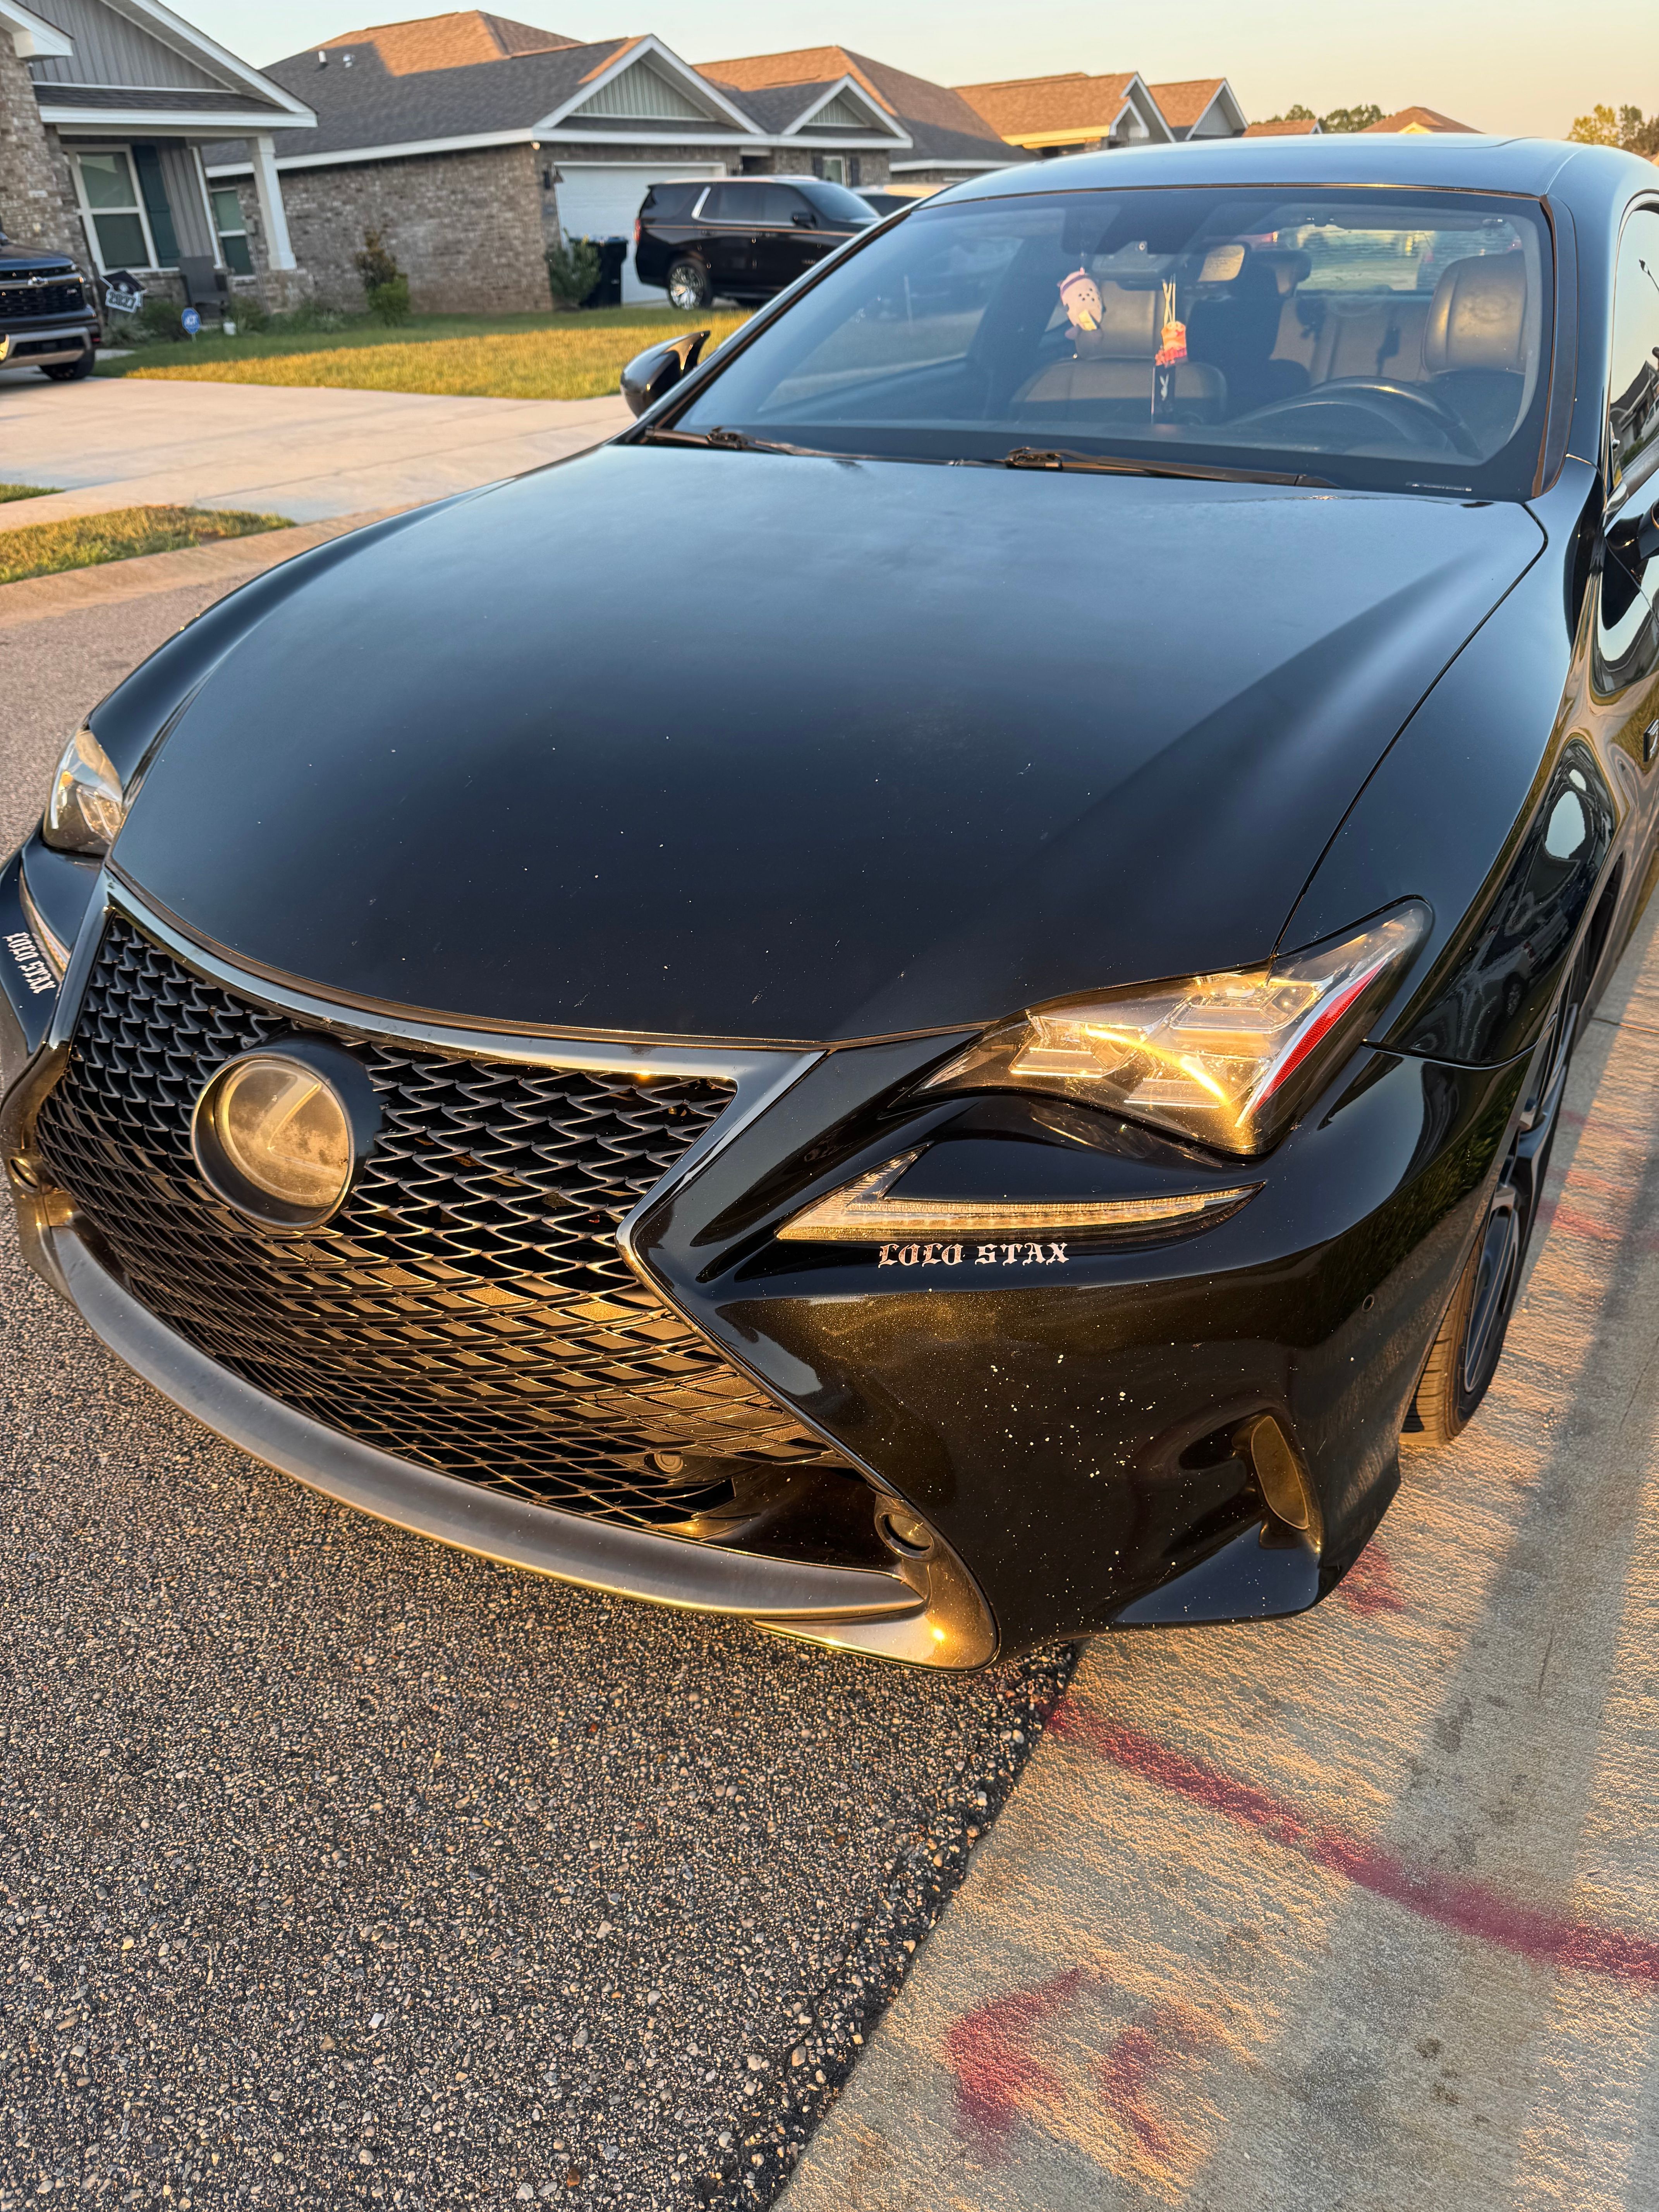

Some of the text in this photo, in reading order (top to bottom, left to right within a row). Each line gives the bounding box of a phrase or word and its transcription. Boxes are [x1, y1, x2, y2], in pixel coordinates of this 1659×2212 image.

[2, 932, 39, 962] LOLO
[878, 1242, 1070, 1268] LOLO STAX
